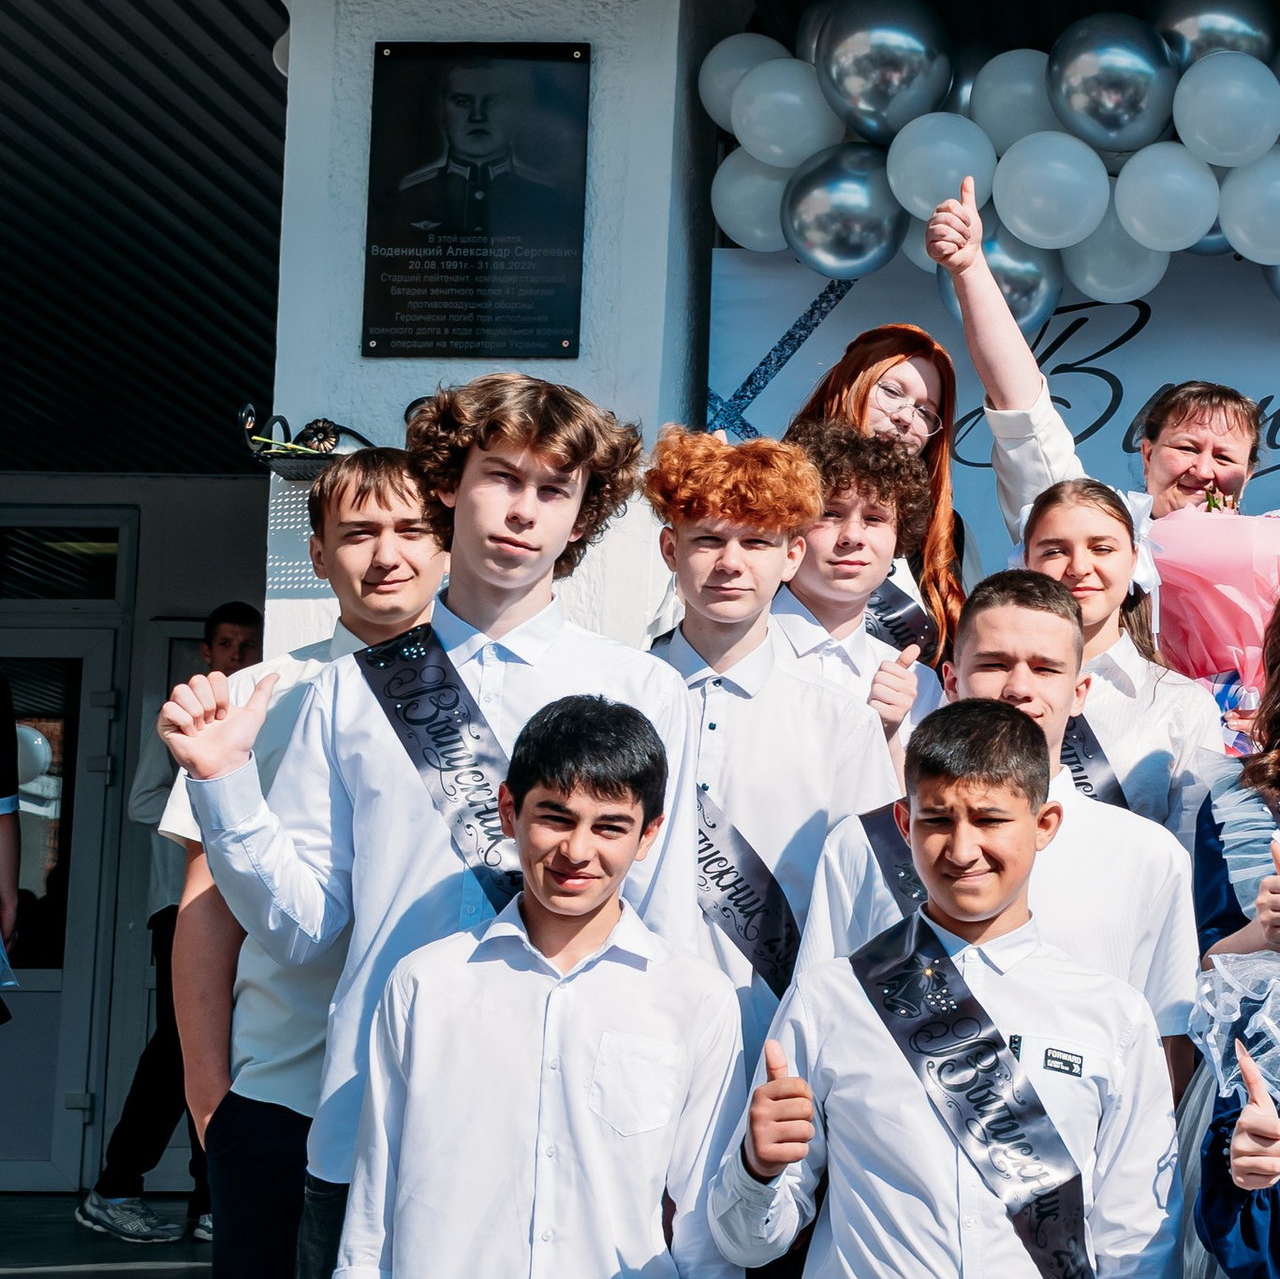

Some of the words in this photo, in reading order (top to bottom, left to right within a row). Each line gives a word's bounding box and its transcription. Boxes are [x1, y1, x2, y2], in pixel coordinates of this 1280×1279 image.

[371, 245, 443, 258] Воденицкий
[446, 245, 511, 259] Александр
[514, 246, 578, 259] Сергеевич
[1047, 1048, 1082, 1065] FORWARD
